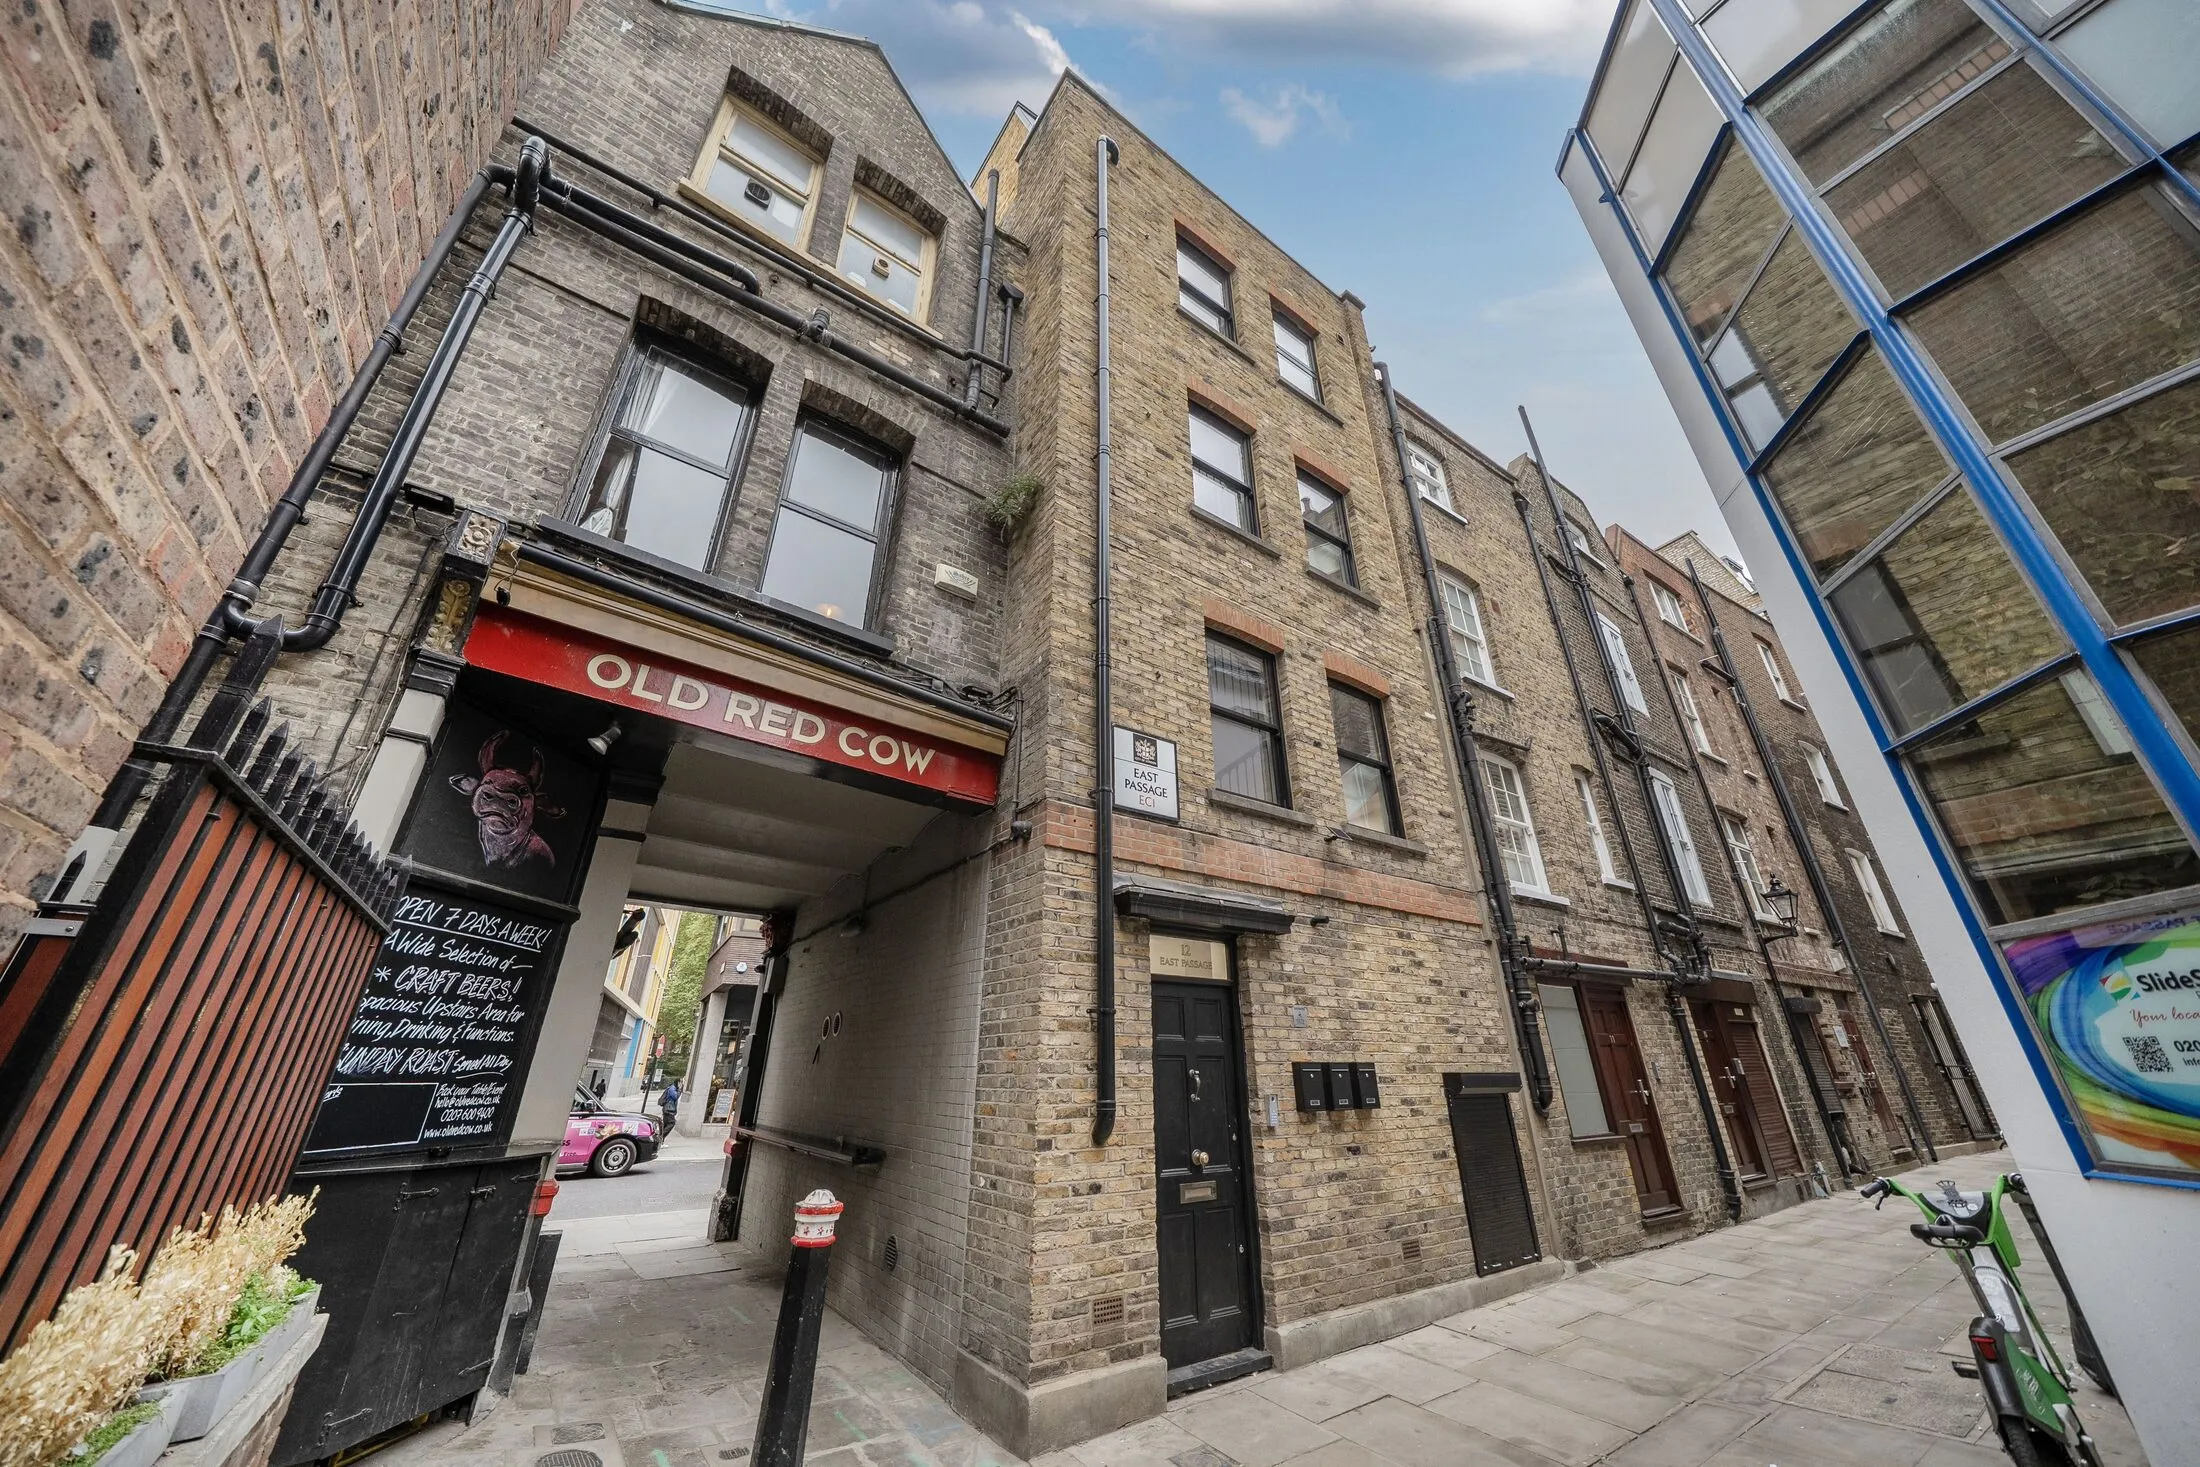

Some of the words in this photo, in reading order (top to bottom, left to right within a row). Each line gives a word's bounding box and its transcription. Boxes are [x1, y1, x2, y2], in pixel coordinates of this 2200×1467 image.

[586, 653, 709, 711] OLD
[723, 690, 826, 744] RED
[838, 726, 937, 775] COW
[1124, 779, 1168, 798] PASSAGE
[1133, 768, 1158, 783] EAST
[444, 908, 462, 928] 7
[458, 911, 502, 936] DAYS
[497, 921, 512, 940] A
[510, 922, 553, 949] WEEK!
[384, 928, 401, 951] A
[396, 930, 436, 957] Wide
[439, 938, 500, 969] Selection
[499, 954, 517, 972] of
[1160, 957, 1179, 967] EAST
[1182, 959, 1213, 970] PASSAGE
[1181, 944, 1192, 956] 12
[394, 964, 462, 995] CRAFT
[422, 995, 479, 1020] Upstairs
[479, 1003, 507, 1023] Area
[506, 1005, 525, 1024] for
[2130, 1009, 2167, 1028] Your
[351, 1016, 391, 1043] ining,
[389, 1018, 453, 1045] Drinking
[463, 1022, 515, 1042] Functions.
[399, 1048, 460, 1075] ROAST
[451, 1054, 487, 1074] Served
[436, 1083, 456, 1097] Book
[453, 1087, 471, 1098] your
